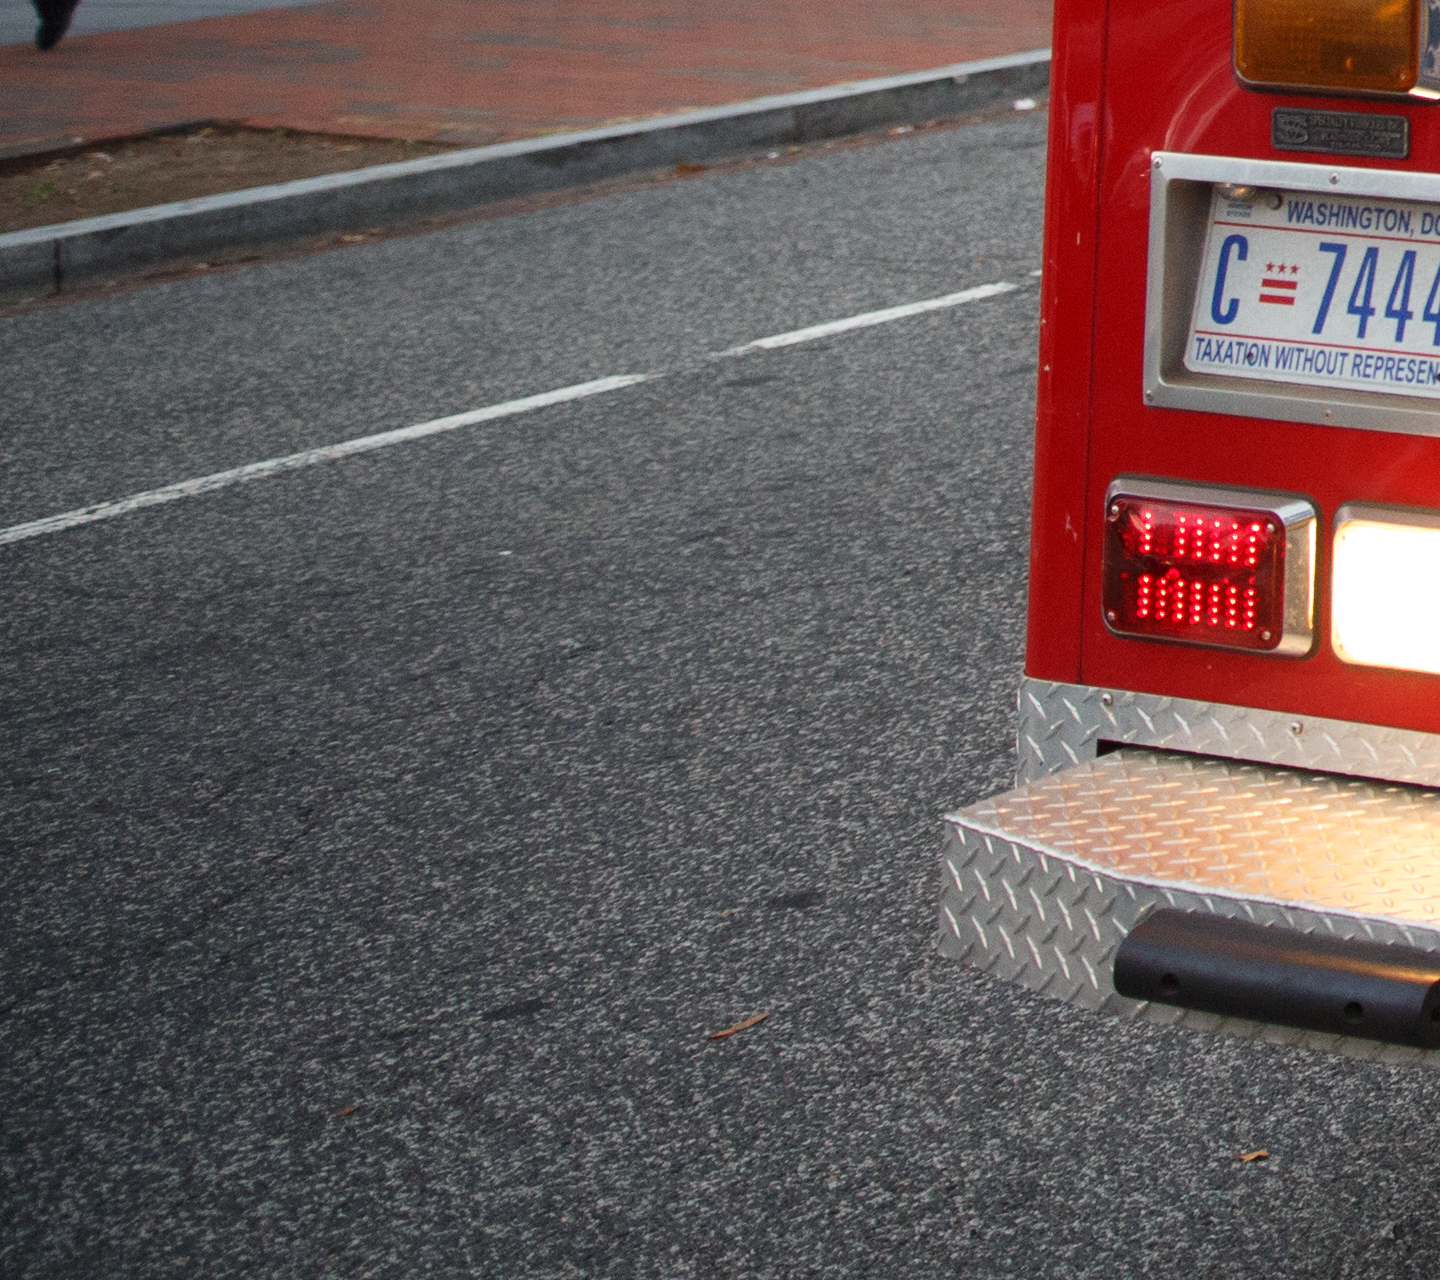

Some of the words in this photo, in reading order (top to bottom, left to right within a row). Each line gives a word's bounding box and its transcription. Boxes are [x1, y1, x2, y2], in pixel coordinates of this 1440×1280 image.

[1287, 199, 1415, 237] WASHINGTON,
[1211, 234, 1249, 325] C
[1195, 337, 1270, 370] TAXATION
[1275, 348, 1346, 375] WITHOUT
